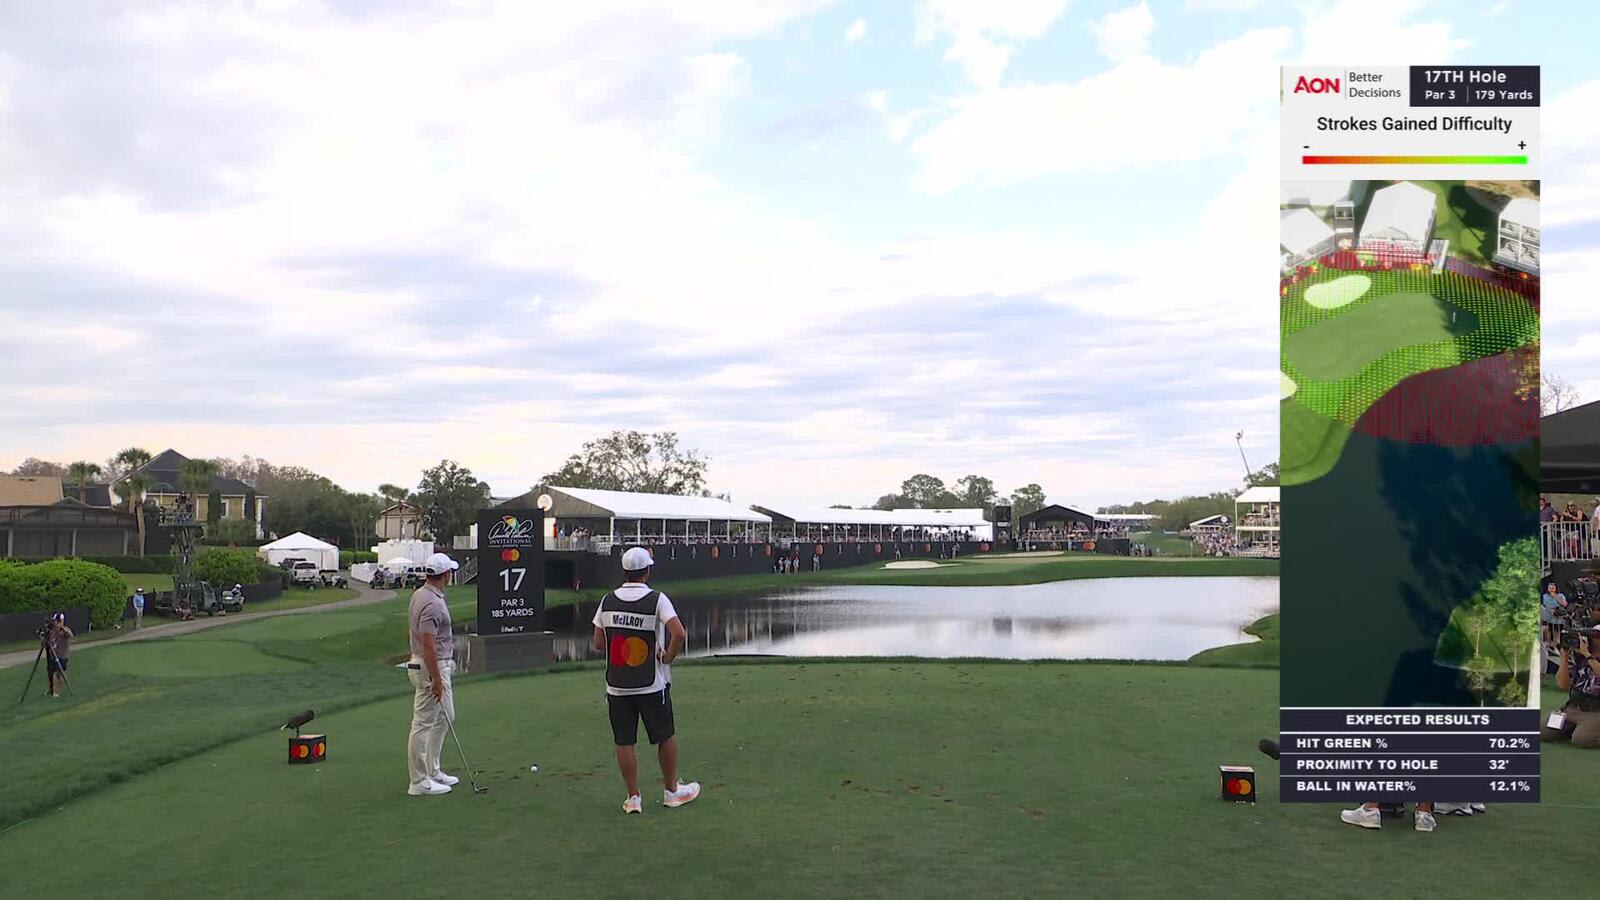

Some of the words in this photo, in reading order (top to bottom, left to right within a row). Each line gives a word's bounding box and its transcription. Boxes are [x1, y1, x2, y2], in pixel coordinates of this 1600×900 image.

[499, 568, 527, 591] 17
[501, 599, 518, 607] PAR
[519, 598, 525, 606] 3
[505, 608, 534, 616] YARDS
[613, 614, 644, 627] McILROY
